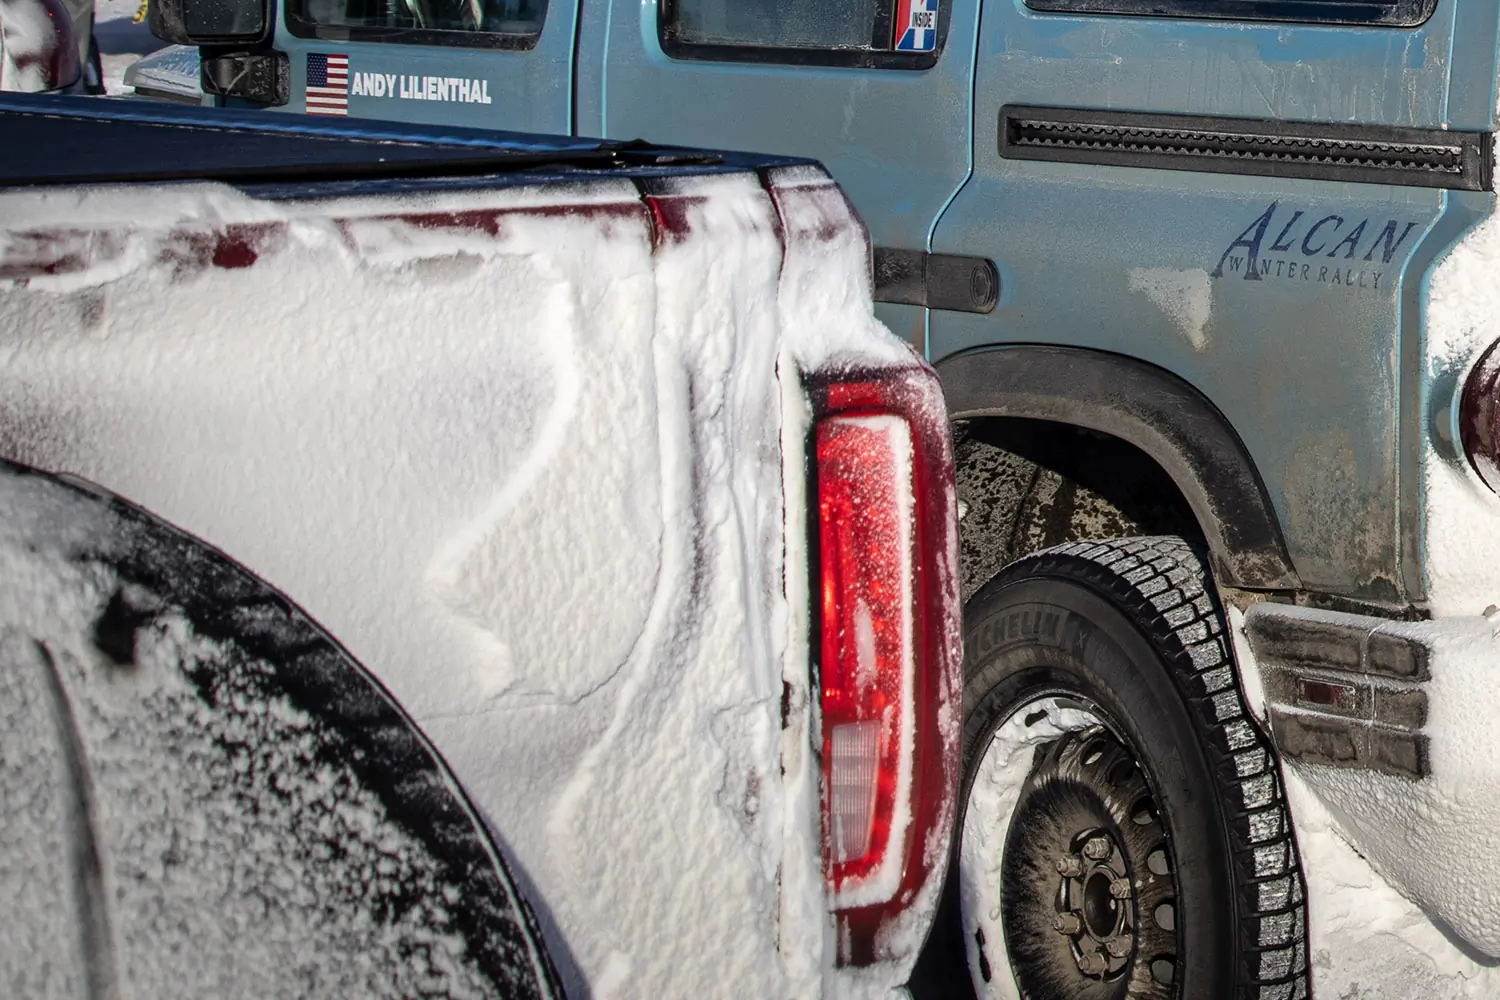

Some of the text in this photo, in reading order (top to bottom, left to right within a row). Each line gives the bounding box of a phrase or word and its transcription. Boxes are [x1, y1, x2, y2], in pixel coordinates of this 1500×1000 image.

[912, 12, 932, 28] INSIDE
[352, 72, 492, 104] ANDY LILIENTHAL
[1210, 199, 1418, 281] ALCAN
[1316, 265, 1383, 290] RALLY
